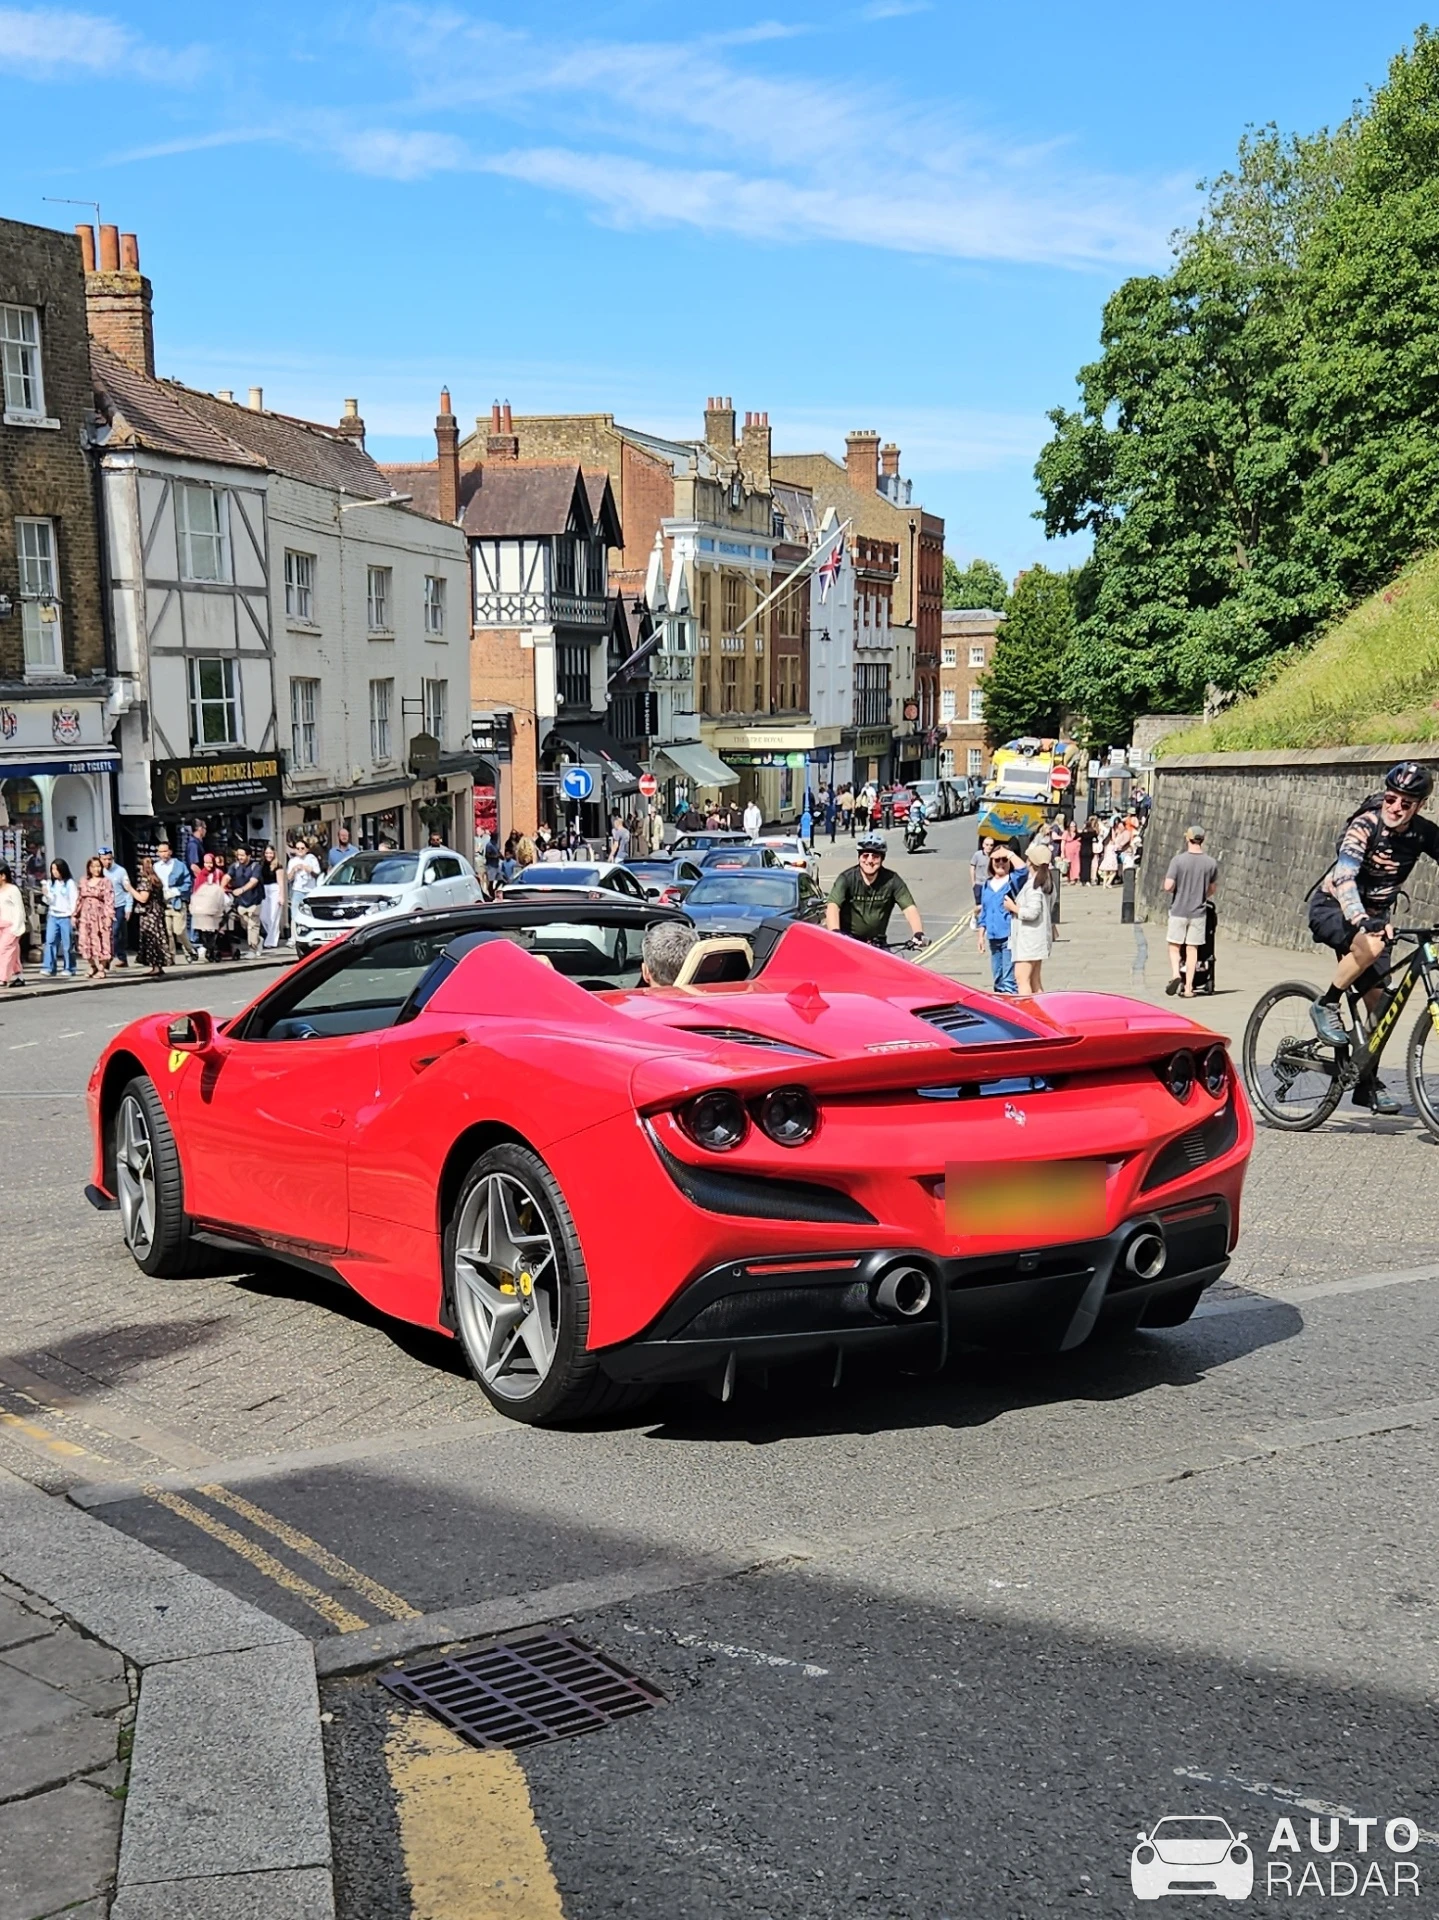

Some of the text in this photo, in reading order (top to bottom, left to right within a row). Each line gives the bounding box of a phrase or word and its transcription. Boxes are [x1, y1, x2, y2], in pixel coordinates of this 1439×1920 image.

[763, 736, 785, 744] ROYAL
[68, 761, 112, 773] TOUR TICKETS
[180, 766, 208, 785] WINDSOR
[208, 762, 247, 783] CONVENIENCE
[1368, 969, 1412, 1054] SCOTT
